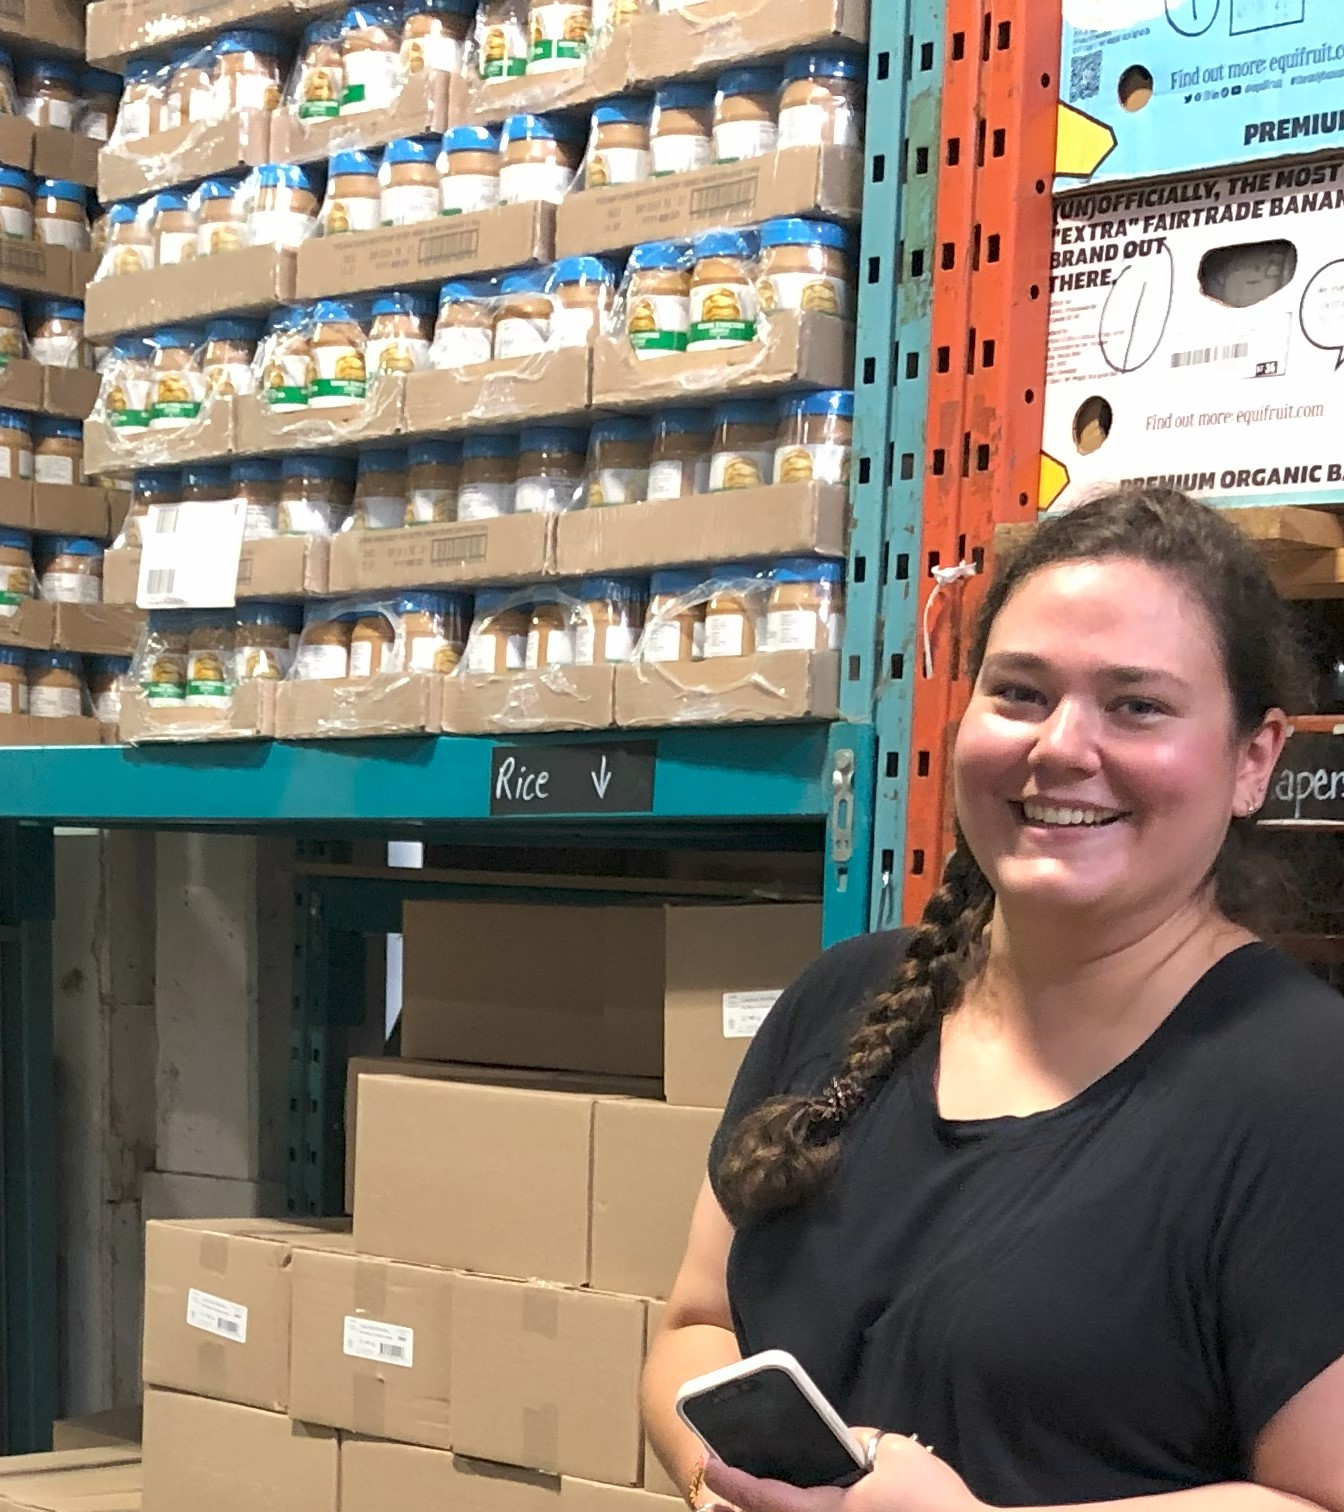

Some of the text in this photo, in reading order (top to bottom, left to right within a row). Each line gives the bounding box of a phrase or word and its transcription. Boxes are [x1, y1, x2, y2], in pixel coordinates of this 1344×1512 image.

[1171, 71, 1199, 90] Find
[1202, 65, 1223, 82] out
[1228, 170, 1274, 196] THE
[1276, 163, 1342, 188] MOST
[1143, 198, 1263, 234] FAIRTRADE
[1050, 236, 1167, 270] BRAND OUT
[1049, 268, 1117, 294] THERE.
[1146, 413, 1172, 431] Find
[1174, 412, 1195, 429] out
[1237, 404, 1324, 430] equifruit.com
[1220, 464, 1322, 489] ORGANIC
[495, 757, 550, 801] Rice
